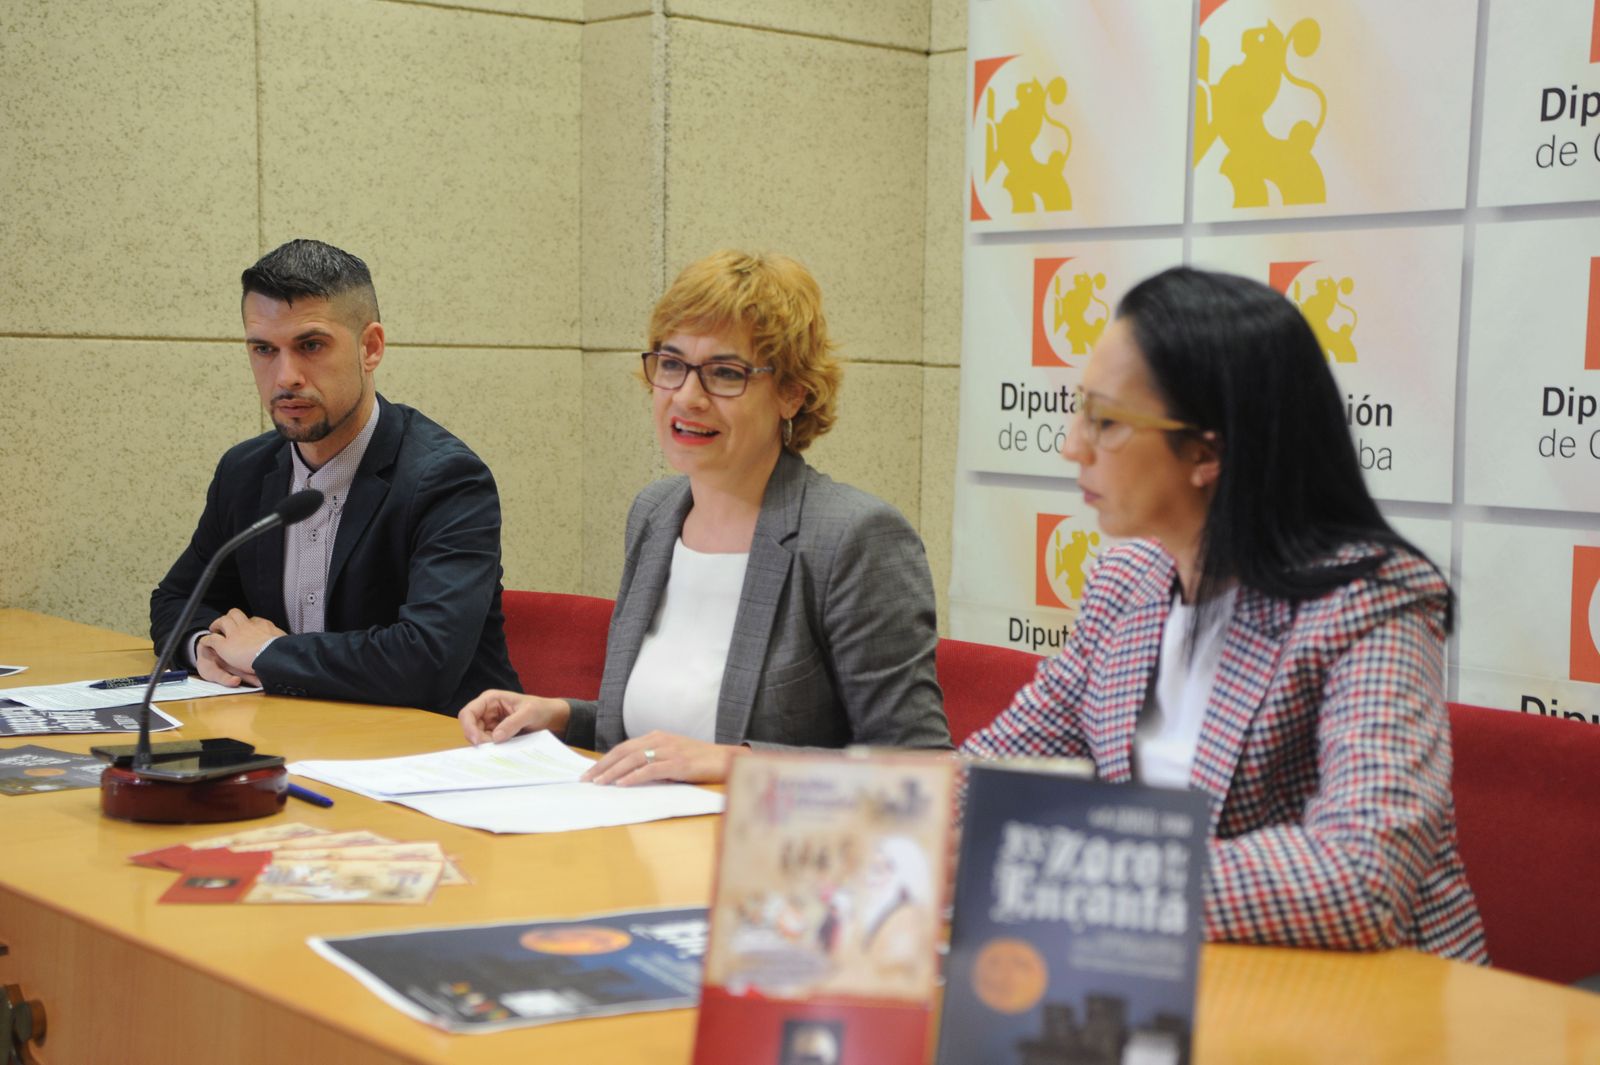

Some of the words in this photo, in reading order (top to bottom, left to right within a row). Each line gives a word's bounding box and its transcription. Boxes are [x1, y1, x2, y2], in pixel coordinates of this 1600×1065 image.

[1540, 84, 1600, 127] Dip
[1536, 134, 1578, 168] de
[1347, 393, 1393, 427] ión
[1542, 386, 1597, 425] Dip
[998, 421, 1028, 452] de
[1036, 423, 1067, 454] Có
[1359, 438, 1393, 471] ba
[1538, 428, 1576, 458] de
